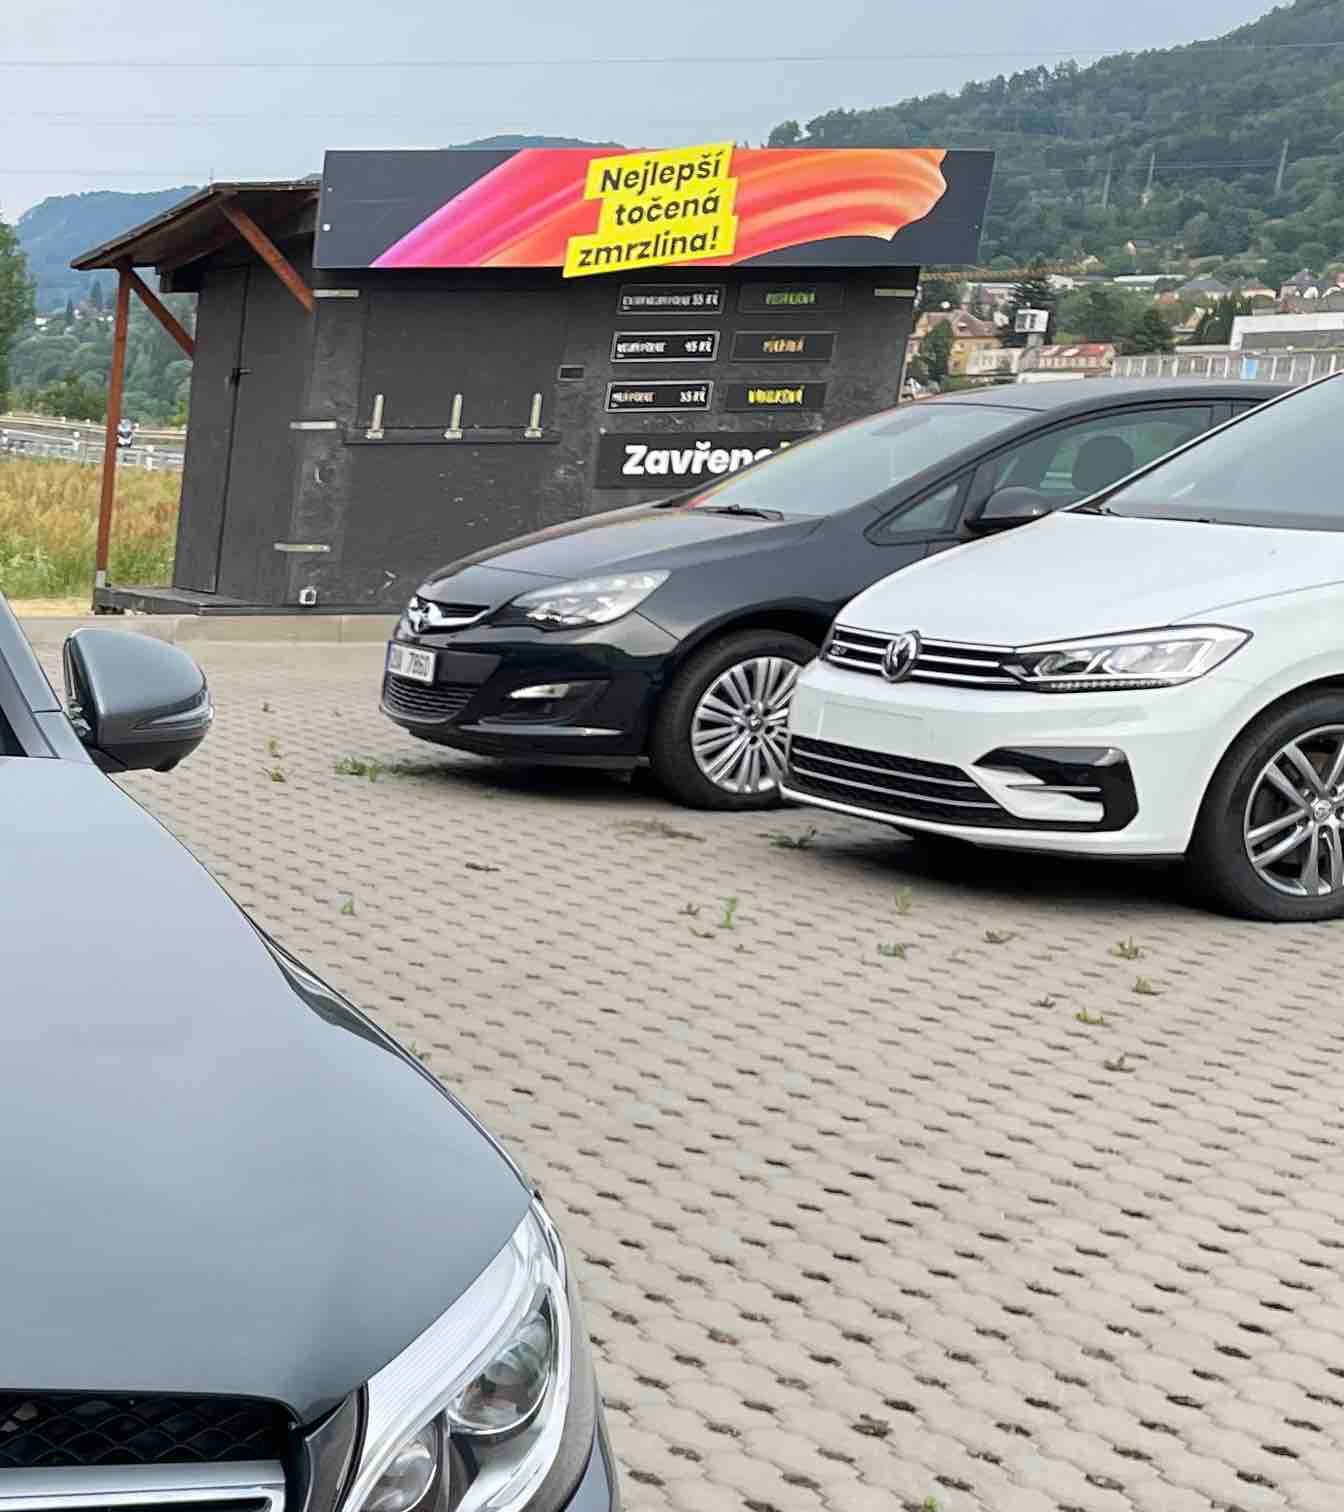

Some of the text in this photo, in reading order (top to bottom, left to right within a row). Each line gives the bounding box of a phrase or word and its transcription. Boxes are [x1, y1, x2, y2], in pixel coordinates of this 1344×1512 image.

[601, 151, 725, 195] Nejlepší
[615, 188, 720, 226] točená
[577, 226, 719, 267] zmrzlina!
[622, 441, 791, 475] Zavřen
